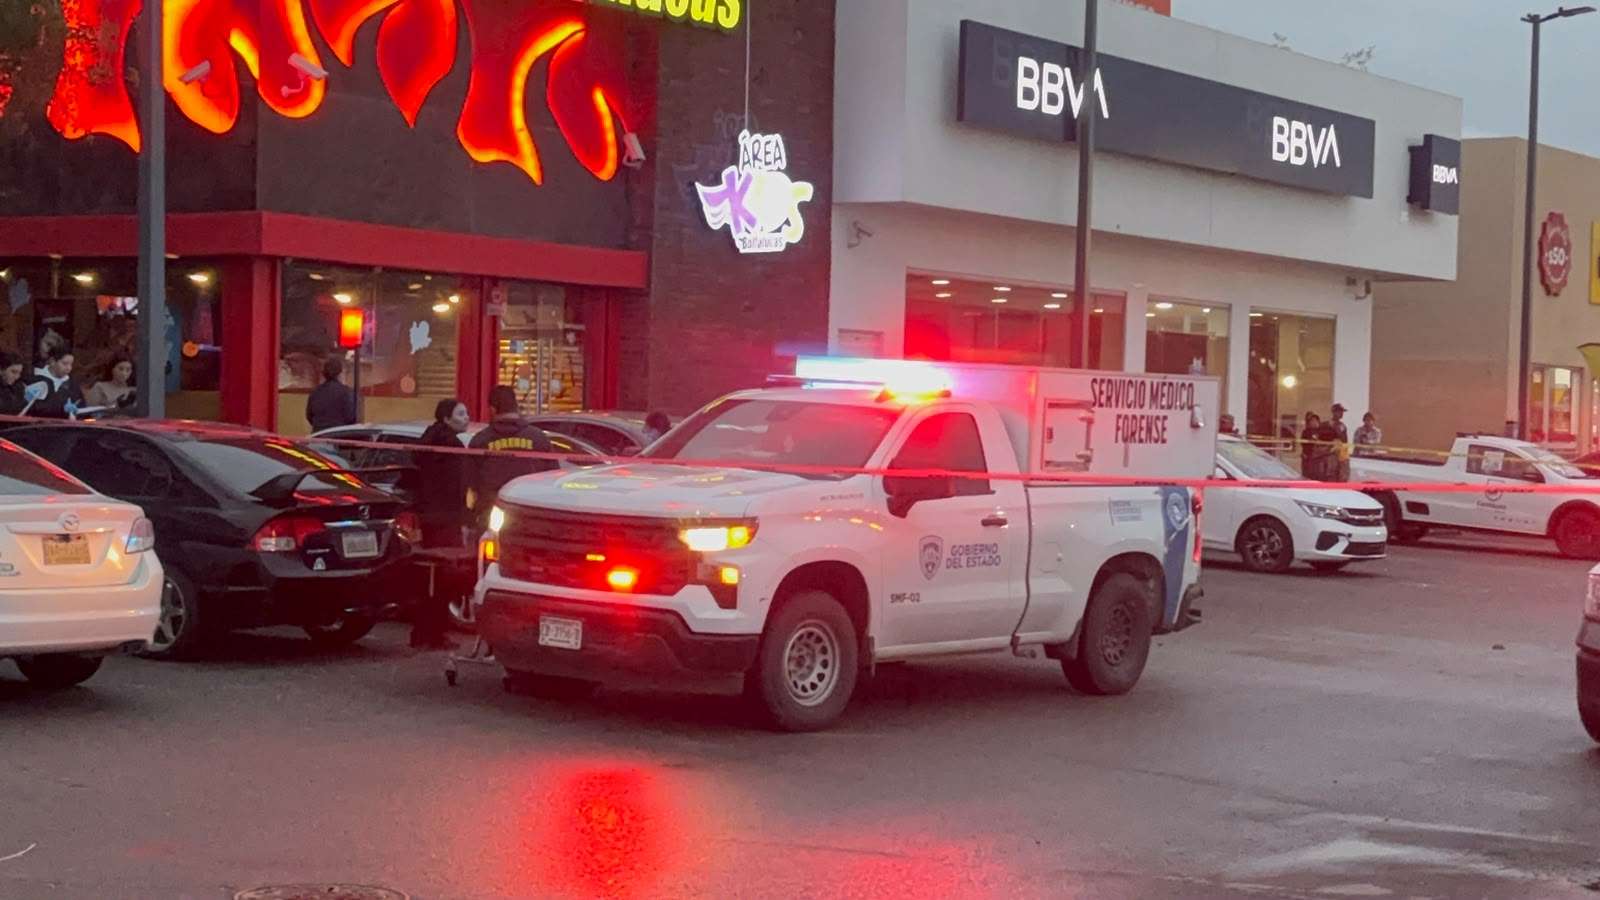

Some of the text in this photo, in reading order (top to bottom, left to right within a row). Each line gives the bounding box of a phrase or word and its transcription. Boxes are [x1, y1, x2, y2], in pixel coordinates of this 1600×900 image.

[1016, 56, 1110, 120] BBVA
[741, 134, 783, 169] ÁREA
[1272, 116, 1341, 168] BBVA
[1433, 164, 1458, 185] BBVA
[1090, 376, 1195, 411] SERVICIO MÉDICO
[1114, 413, 1168, 444] FORENSE
[945, 554, 1002, 570] DEL ESTADO
[950, 542, 999, 557] GOBIERNO
[890, 592, 921, 604] SMF-02
